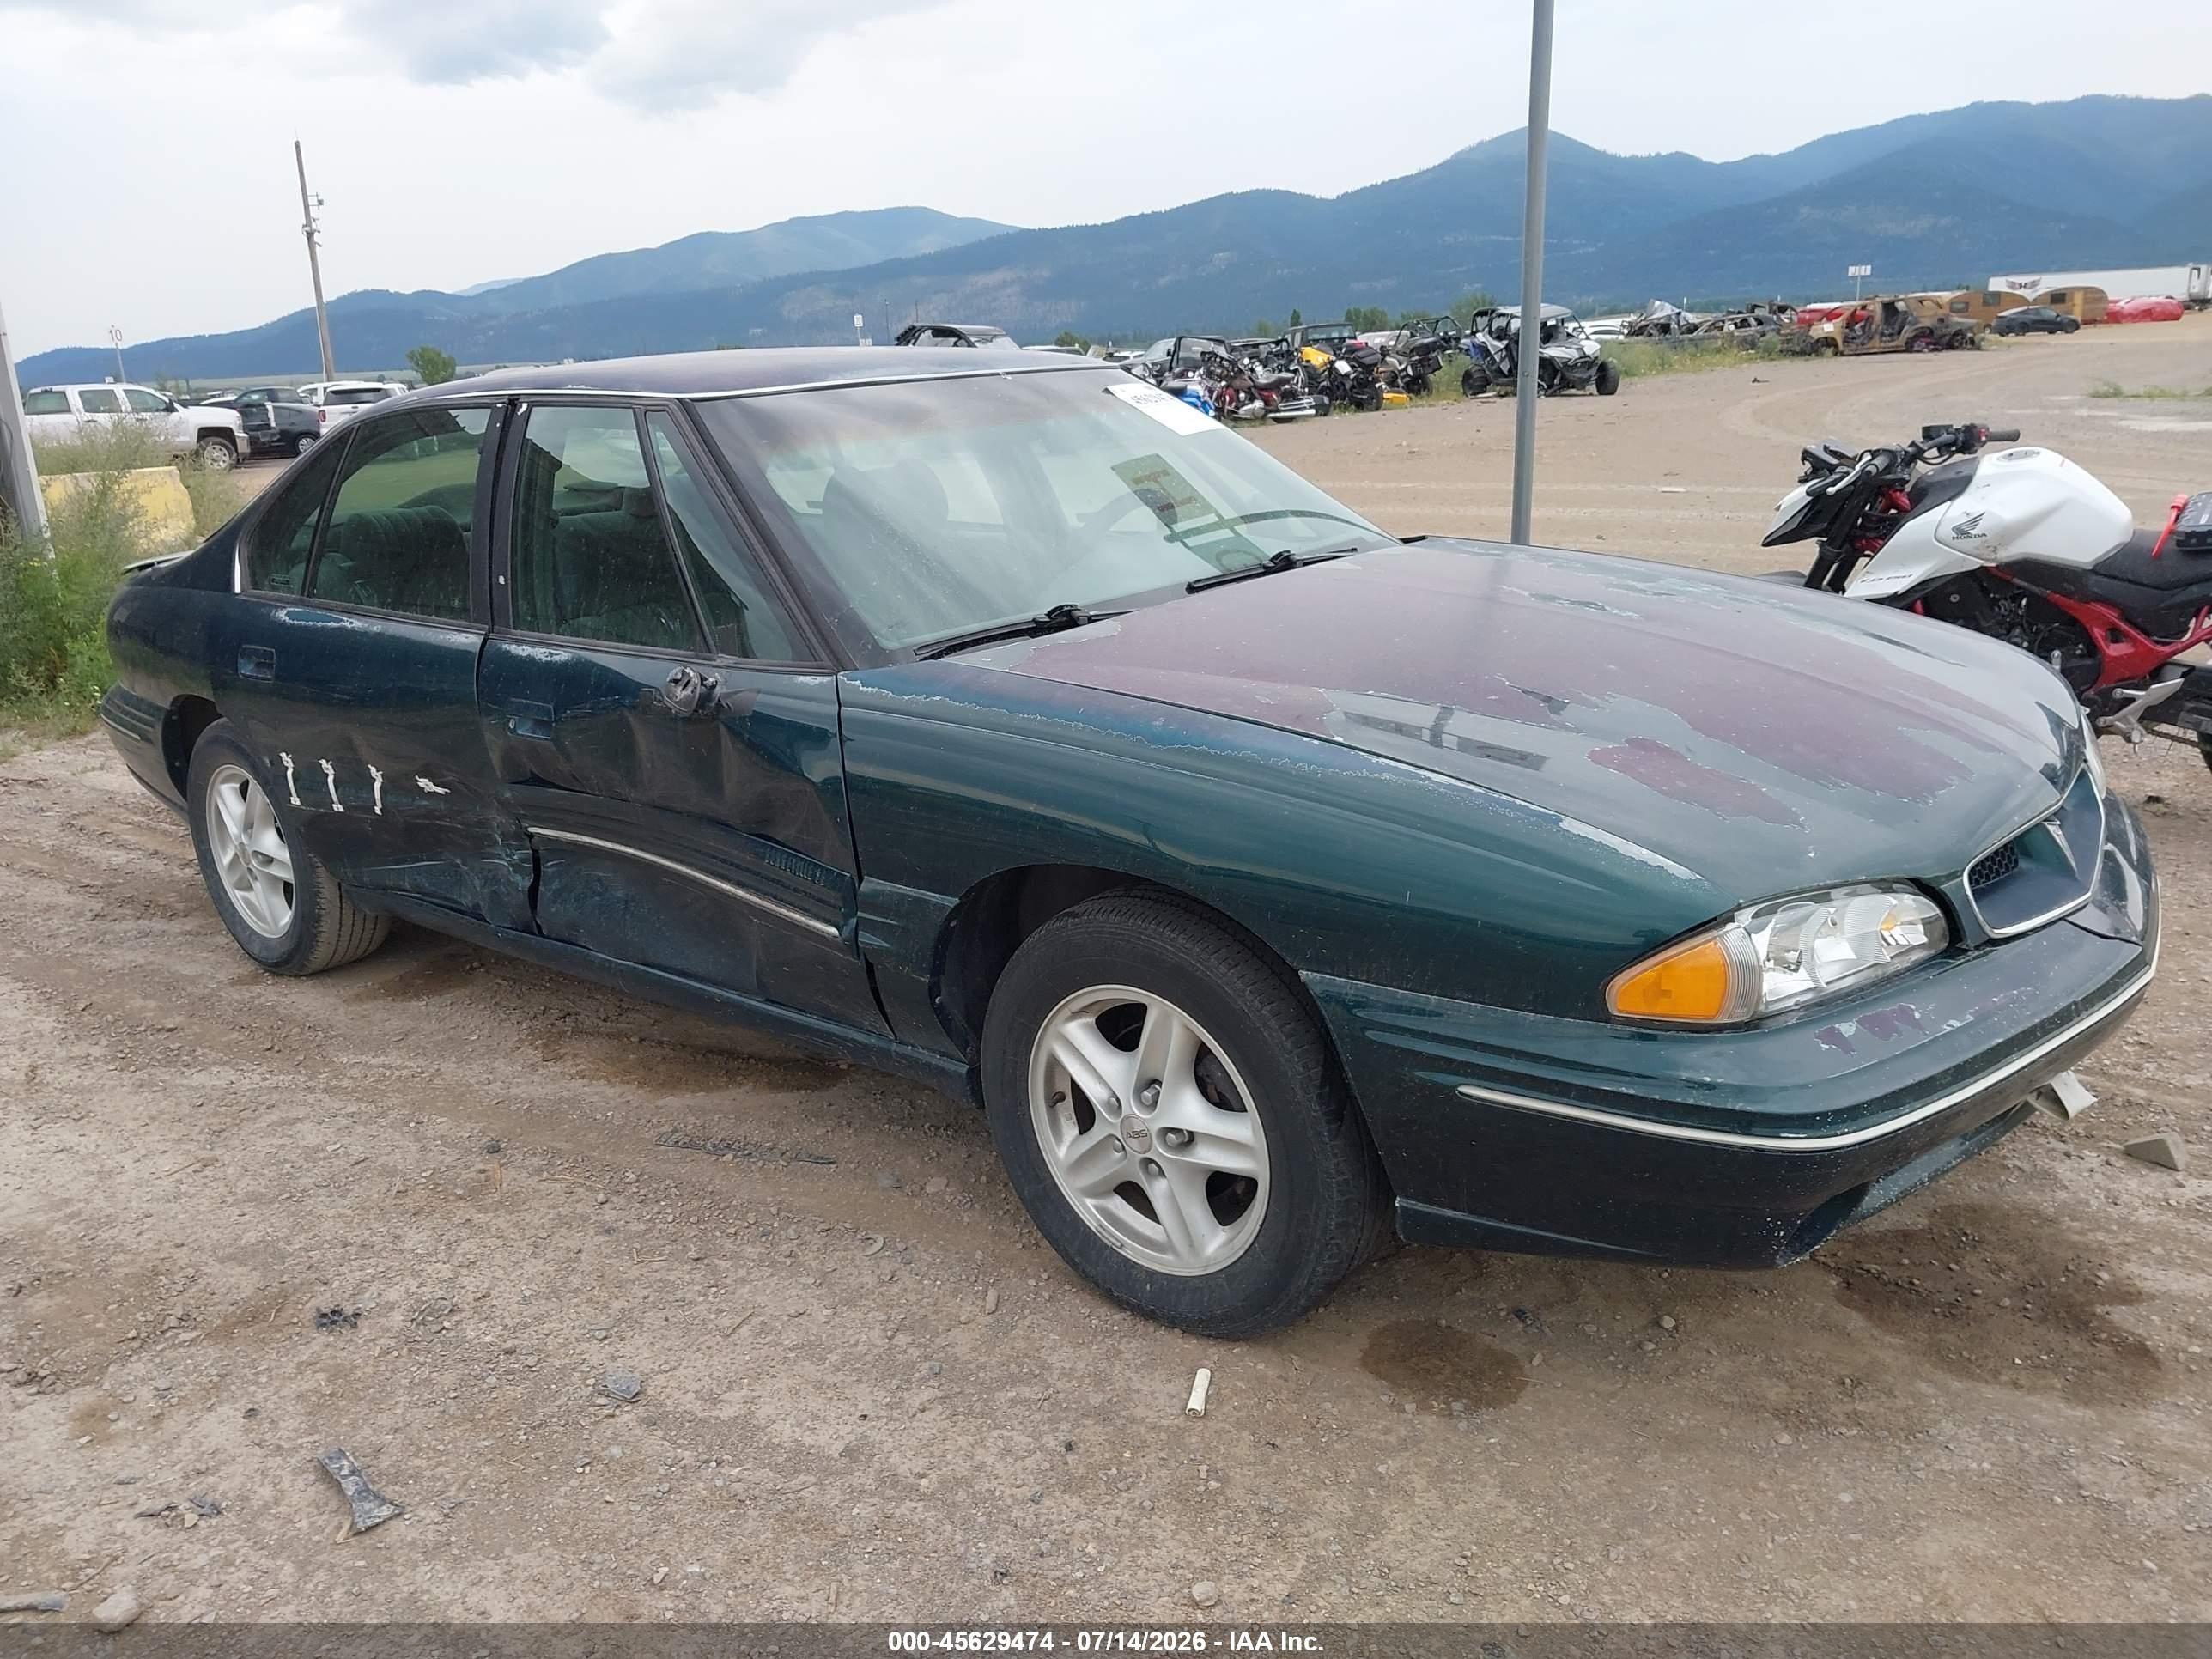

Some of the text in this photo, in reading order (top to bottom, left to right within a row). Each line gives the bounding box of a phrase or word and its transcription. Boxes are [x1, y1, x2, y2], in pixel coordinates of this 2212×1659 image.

[109, 329, 123, 342] 10
[1952, 532, 1988, 541] HONDA
[1126, 1129, 1148, 1139] ABS
